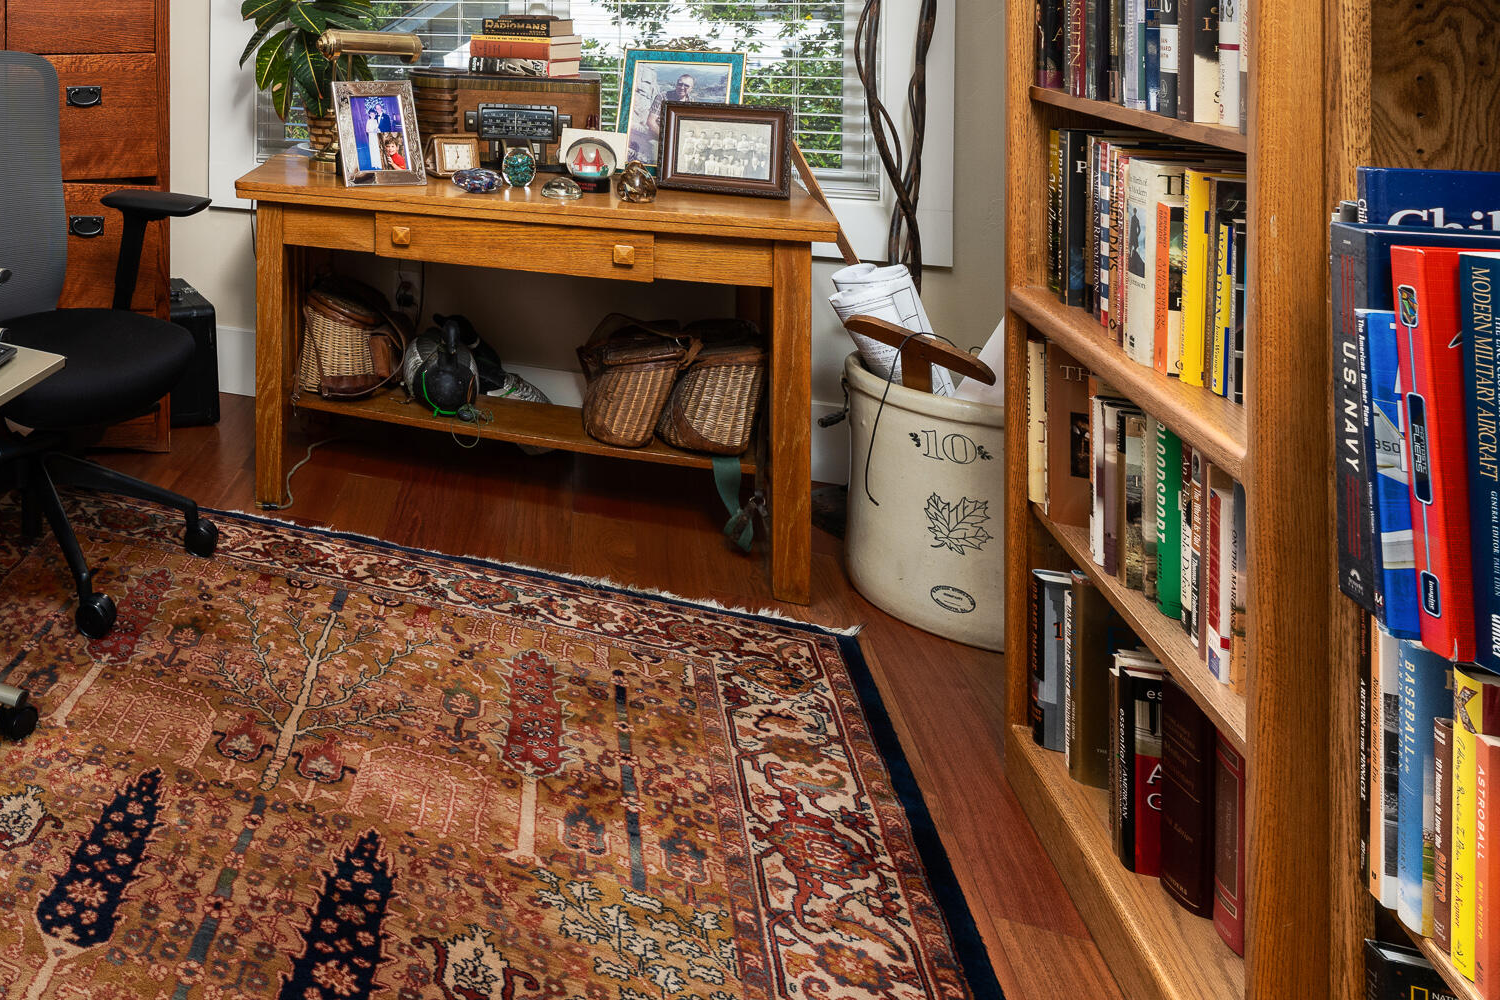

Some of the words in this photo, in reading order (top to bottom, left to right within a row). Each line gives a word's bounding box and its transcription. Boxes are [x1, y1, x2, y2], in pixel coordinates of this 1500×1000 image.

[485, 19, 547, 31] RADIOMANS
[1109, 159, 1118, 182] THE
[1109, 184, 1118, 230] NINETY
[1358, 198, 1368, 224] Chil
[1109, 235, 1118, 271] DAYS
[1214, 231, 1224, 320] WOODEN
[1471, 267, 1492, 334] MODERN
[1343, 342, 1357, 389] U.S.
[1359, 334, 1367, 371] American
[1474, 336, 1495, 405] MILITARY
[921, 429, 980, 464] 10
[1344, 398, 1360, 473] NAVY
[1412, 423, 1423, 473] FLIERS
[1419, 426, 1427, 474] FANTASTIC
[1477, 405, 1498, 482] AIRCRAFT
[1182, 455, 1190, 475] An
[1193, 487, 1201, 500] The
[1193, 502, 1201, 522] World
[1182, 481, 1191, 552] Honorable
[1231, 529, 1237, 546] ON
[1181, 555, 1190, 600] Defeat
[1191, 558, 1199, 585] Thomas
[1404, 660, 1415, 756] BASEBALL
[1372, 751, 1378, 764] an
[1476, 764, 1486, 860] ASTROBALL
[1434, 848, 1447, 903] GIANTS
[1476, 881, 1484, 902] BEN
